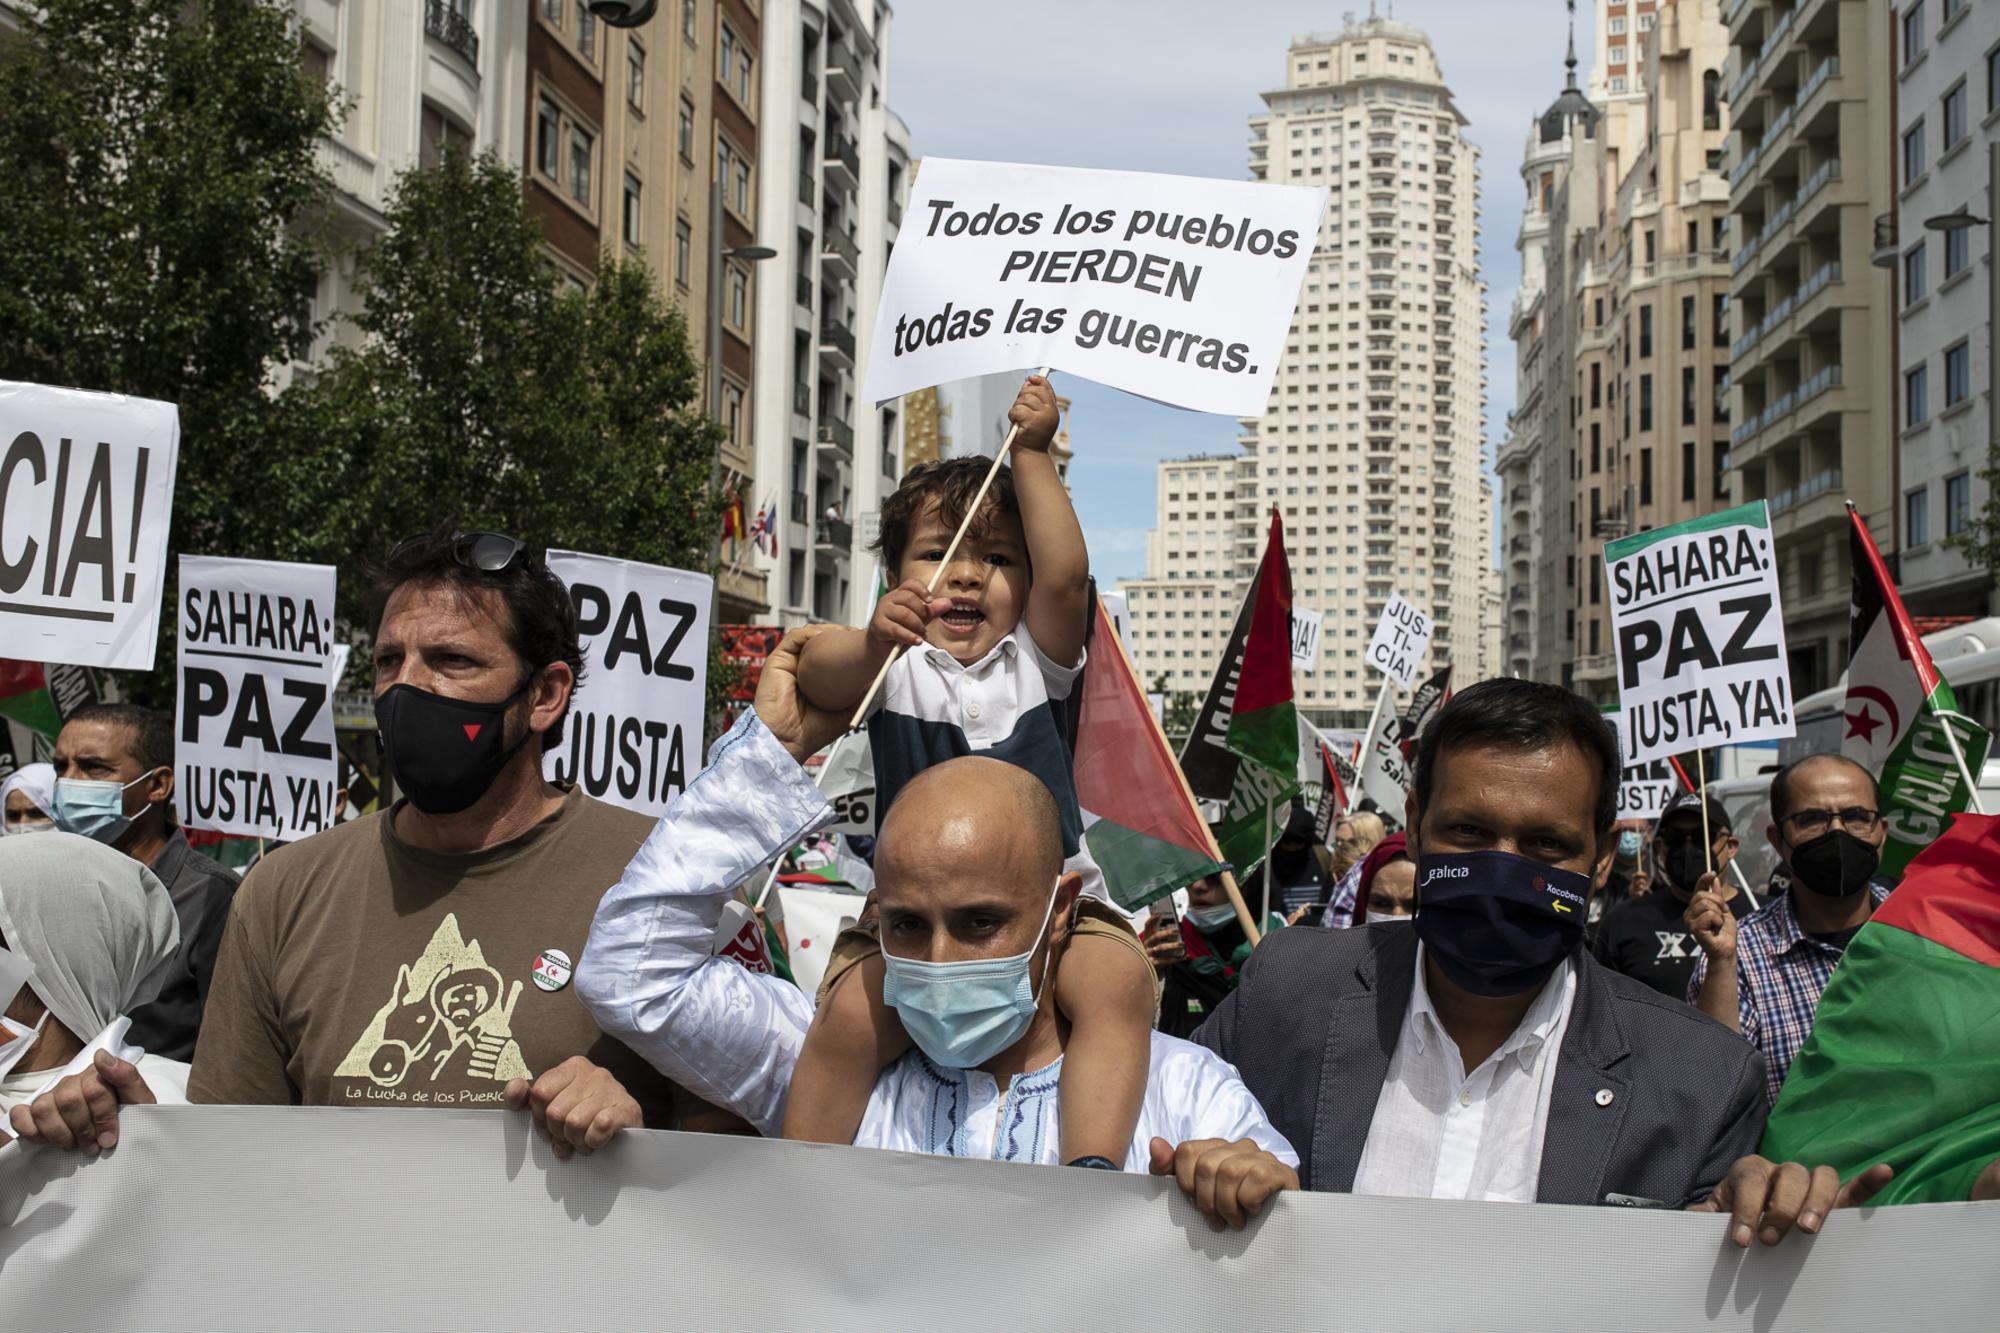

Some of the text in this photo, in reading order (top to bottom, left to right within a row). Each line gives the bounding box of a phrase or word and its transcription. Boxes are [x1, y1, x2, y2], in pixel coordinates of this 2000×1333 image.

[926, 199, 1300, 259] Todos los pueblos
[999, 249, 1202, 302] PIERDEN
[893, 299, 1258, 375] todas las guerras.
[1614, 529, 1769, 606] SAHARA:
[185, 588, 330, 657] SAHARA:
[569, 583, 697, 682] PAZ
[1389, 601, 1427, 637] JUS-
[1394, 625, 1411, 651] TI-
[1619, 593, 1779, 690] PAZ
[1375, 644, 1412, 681] CIA!
[182, 667, 332, 760] PAZ
[555, 711, 686, 804] JUSTA
[1617, 785, 1671, 811] USTA
[1421, 865, 1469, 886] galicia
[346, 1086, 361, 1098] La
[367, 1086, 407, 1100] Lucha
[413, 1091, 429, 1100] de
[434, 1091, 455, 1102] los
